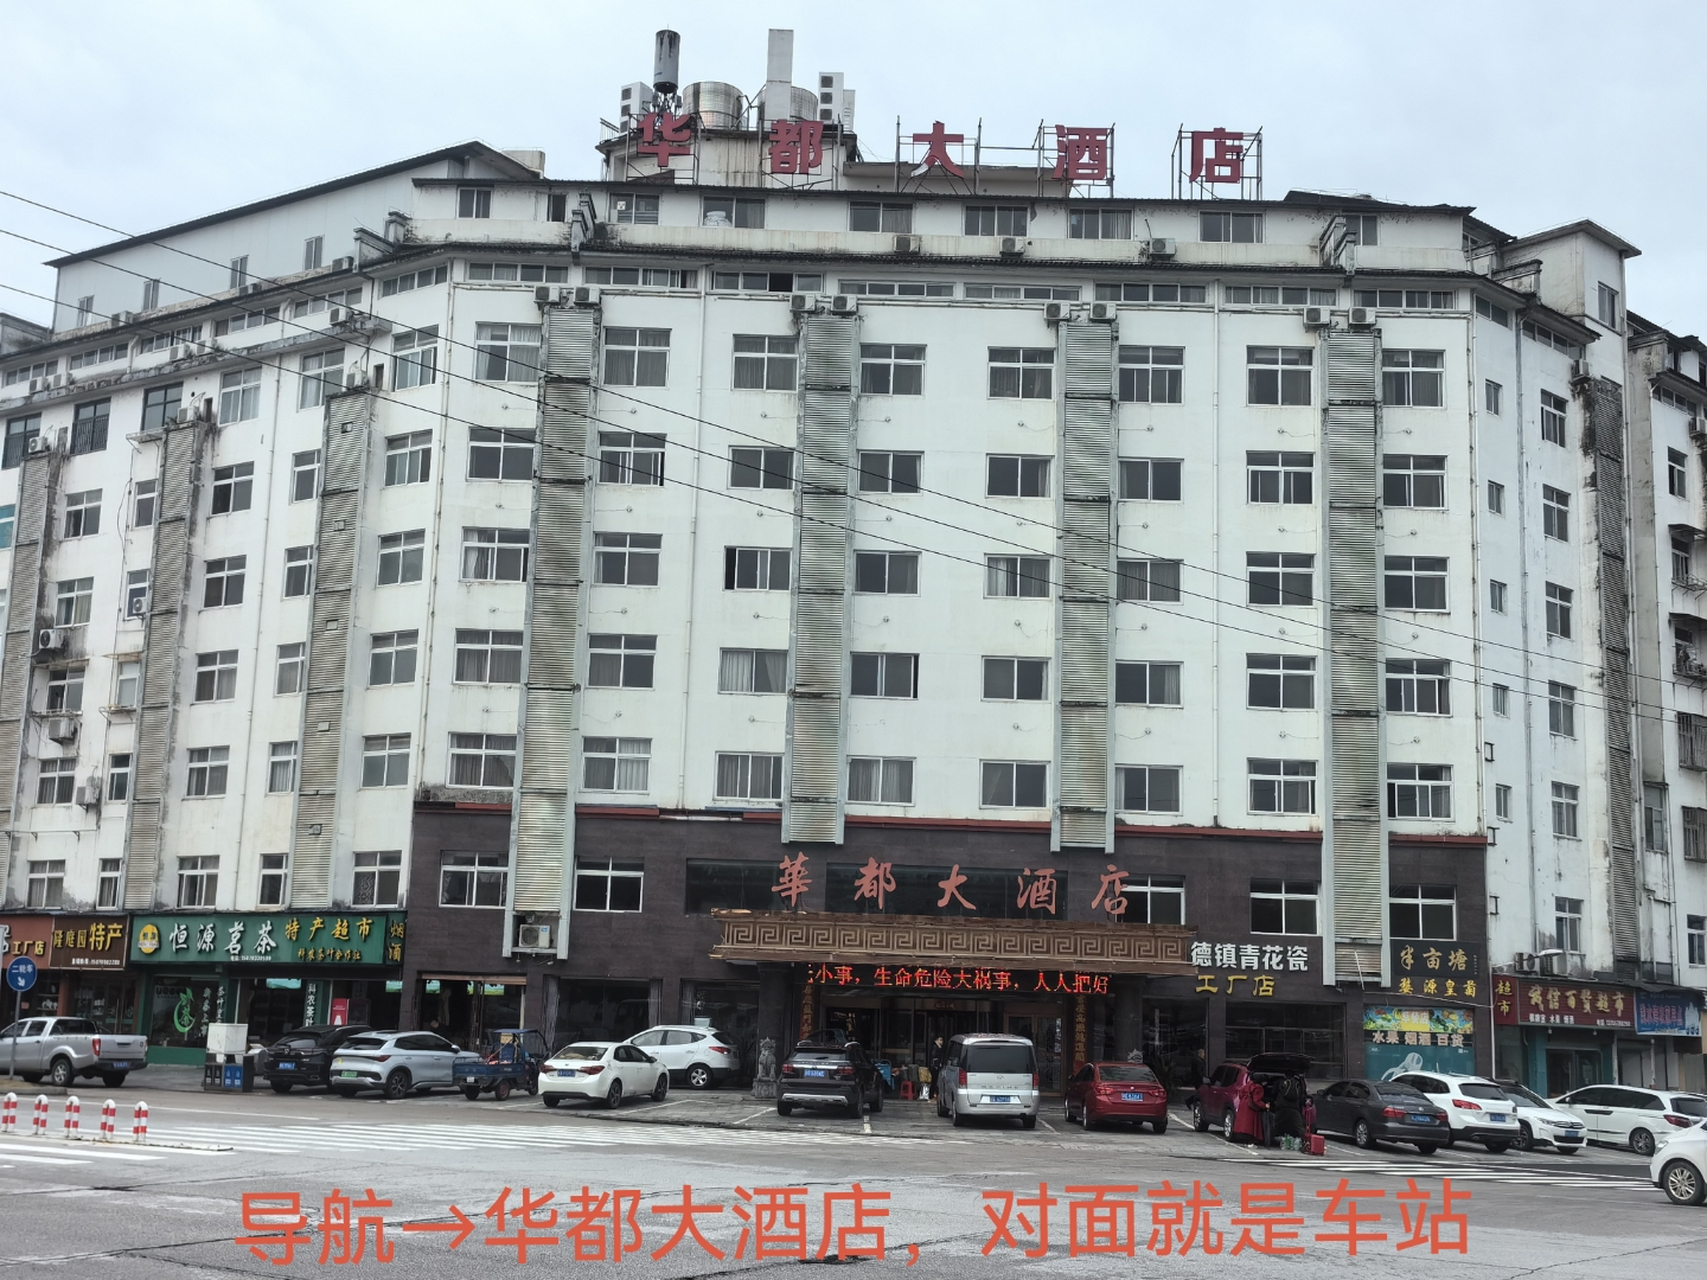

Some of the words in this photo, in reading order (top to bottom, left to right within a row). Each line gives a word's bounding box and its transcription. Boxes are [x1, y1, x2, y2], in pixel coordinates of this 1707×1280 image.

[636, 111, 1244, 184] 华都大酒店
[770, 852, 1130, 915] 華都大酒店
[12, 941, 45, 955] 工厂店
[168, 920, 277, 955] 恒源茗茶
[284, 916, 373, 941] 特产超市
[388, 919, 405, 962] 烟酒
[11, 964, 34, 974] 二轮车
[1190, 941, 1309, 971] 德镇青花瓷
[1195, 974, 1275, 997] 工厂店
[1398, 976, 1477, 998] 婺源皇菊
[1495, 980, 1513, 1017] 超市
[1372, 1030, 1400, 1045] 水果
[1404, 1031, 1432, 1046] 烟酒
[1436, 1033, 1464, 1048] 百货
